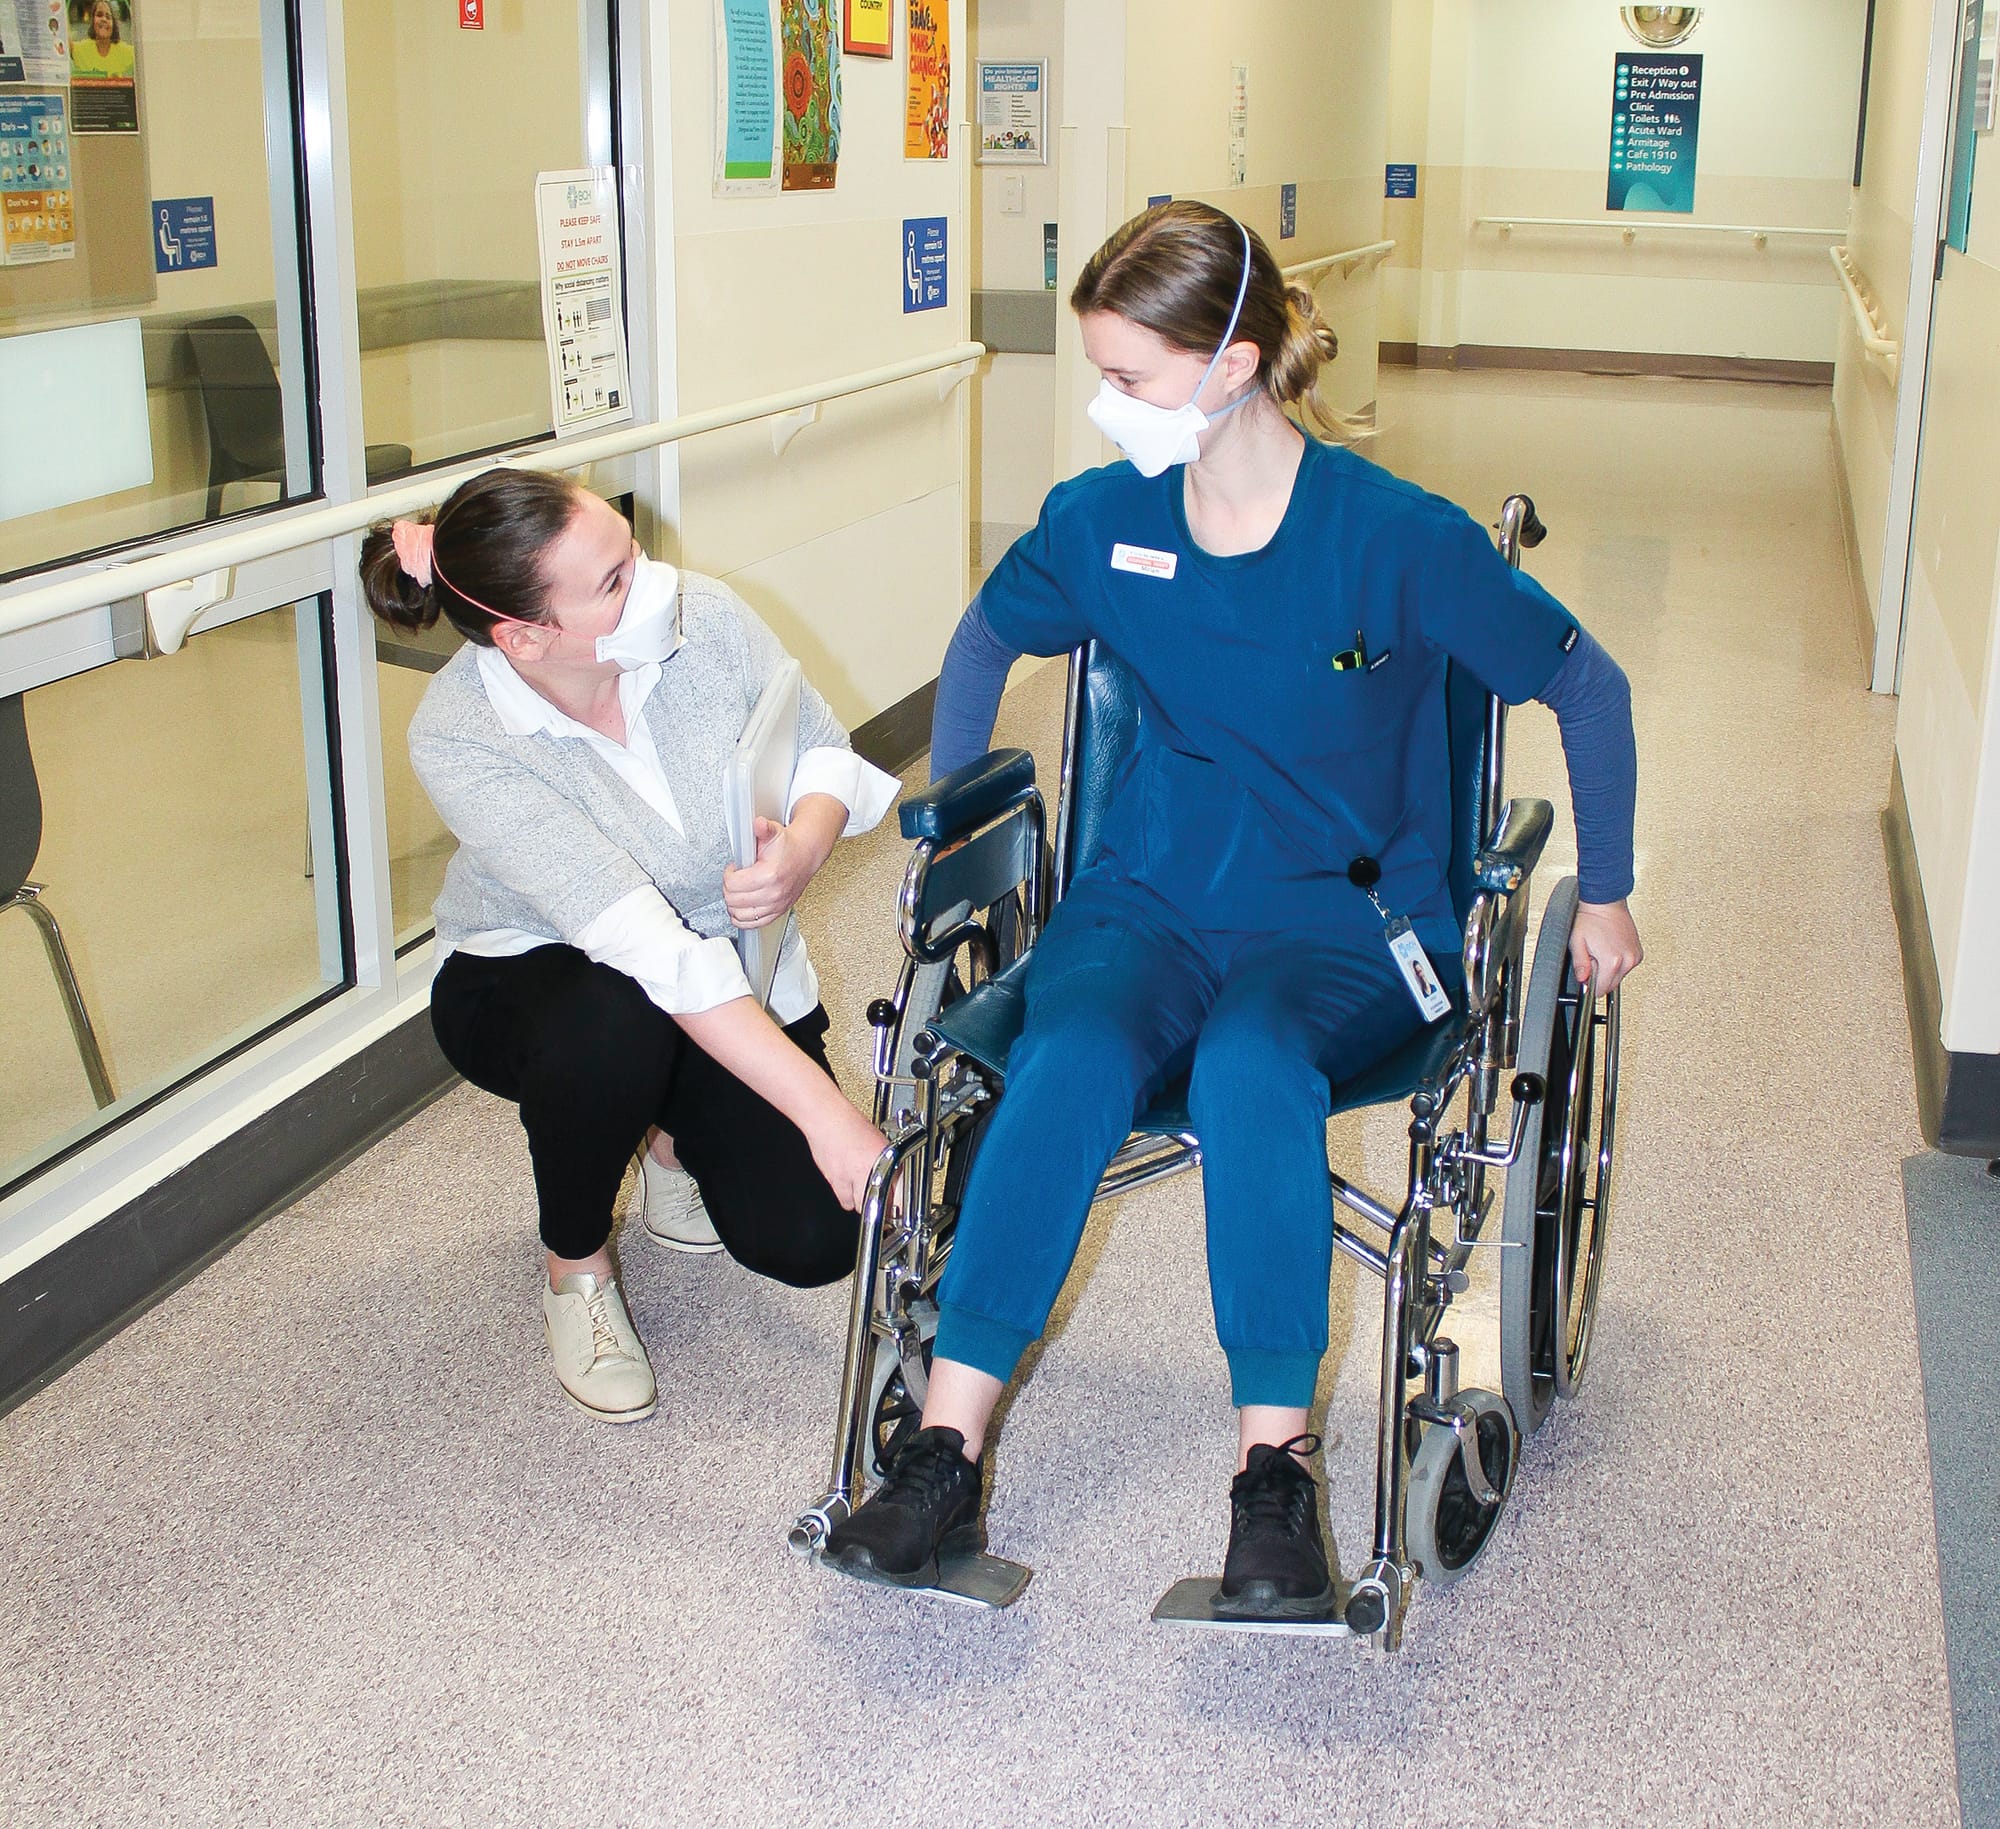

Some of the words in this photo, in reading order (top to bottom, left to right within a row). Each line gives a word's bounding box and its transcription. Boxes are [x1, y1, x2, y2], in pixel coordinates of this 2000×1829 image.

[910, 32, 929, 53] MAKE
[1631, 65, 1678, 77] Reception
[984, 75, 1037, 83] HEALTHCARE
[1631, 77, 1649, 87] Exit
[1650, 78, 1657, 88] /
[1658, 78, 1680, 90] Way
[1681, 80, 1697, 89] out
[993, 83, 1028, 91] RIGHTS?
[1630, 90, 1647, 100] Pre
[1648, 90, 1695, 100] Admission
[1629, 102, 1655, 112] Clinic
[1629, 114, 1660, 124] Toilets
[1628, 126, 1656, 136] Acute
[1657, 126, 1683, 136] Ward
[1627, 138, 1670, 149] Armitage
[1626, 150, 1649, 159] Cafe
[1651, 150, 1678, 160] 1910
[1626, 162, 1672, 175] Pathology
[559, 217, 577, 228] PLEASE
[578, 216, 589, 226] KEEP
[589, 214, 601, 225] SAFE
[561, 239, 574, 249] STAY
[574, 237, 586, 247] 1.5m
[586, 235, 602, 246] APART
[556, 261, 564, 271] DO
[565, 259, 576, 270] NOT
[577, 257, 591, 267] MOVE
[591, 255, 609, 265] CHAIRS
[555, 282, 564, 291] Why
[564, 279, 575, 289] social
[576, 278, 595, 288] distancing
